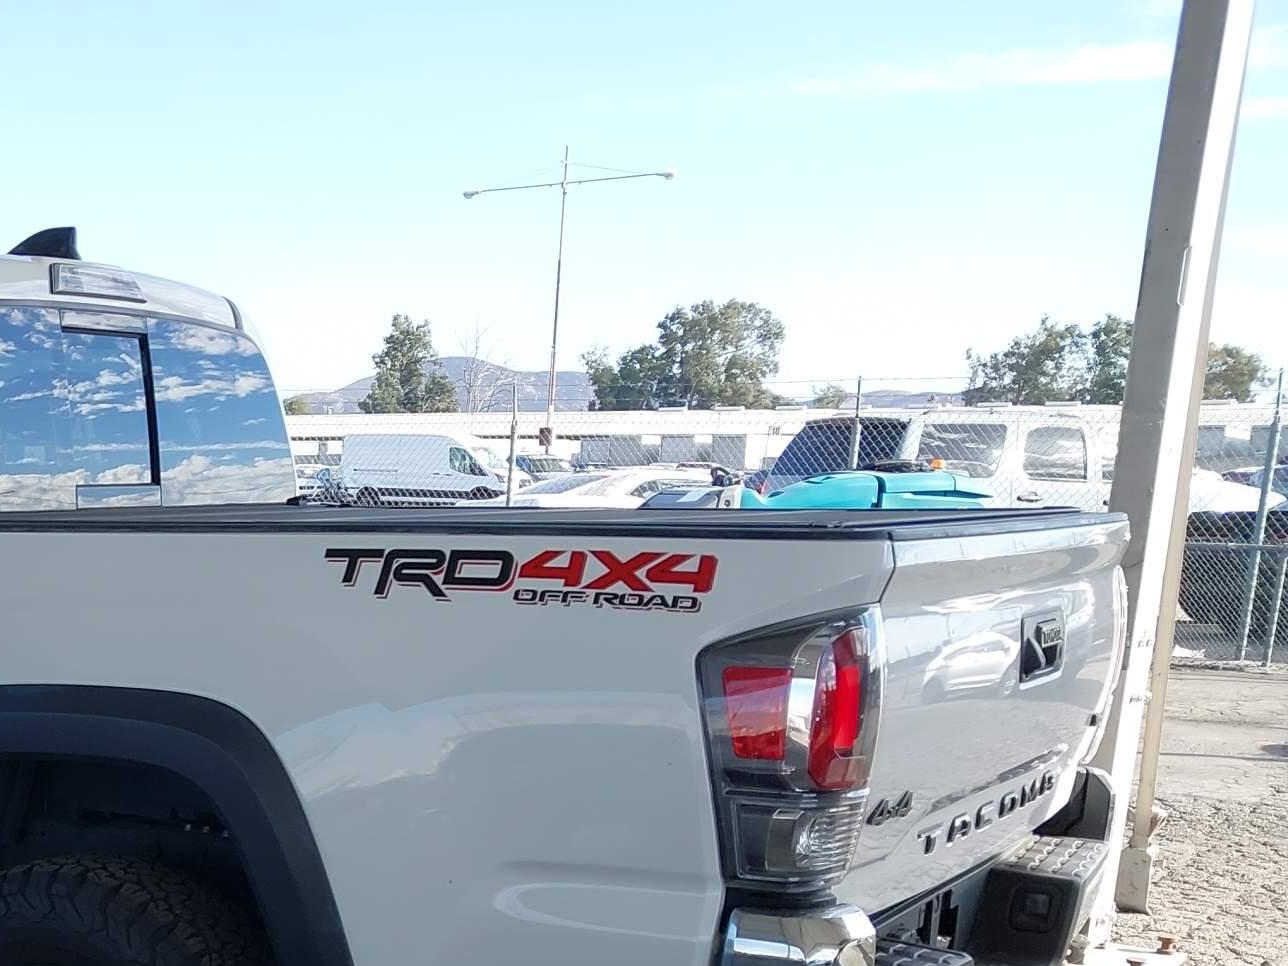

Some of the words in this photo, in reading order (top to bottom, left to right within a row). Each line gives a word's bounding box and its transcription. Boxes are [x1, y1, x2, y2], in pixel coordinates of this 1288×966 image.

[324, 548, 518, 601] TRD
[592, 592, 702, 613] ROAD
[917, 769, 1056, 855] TACOMA
